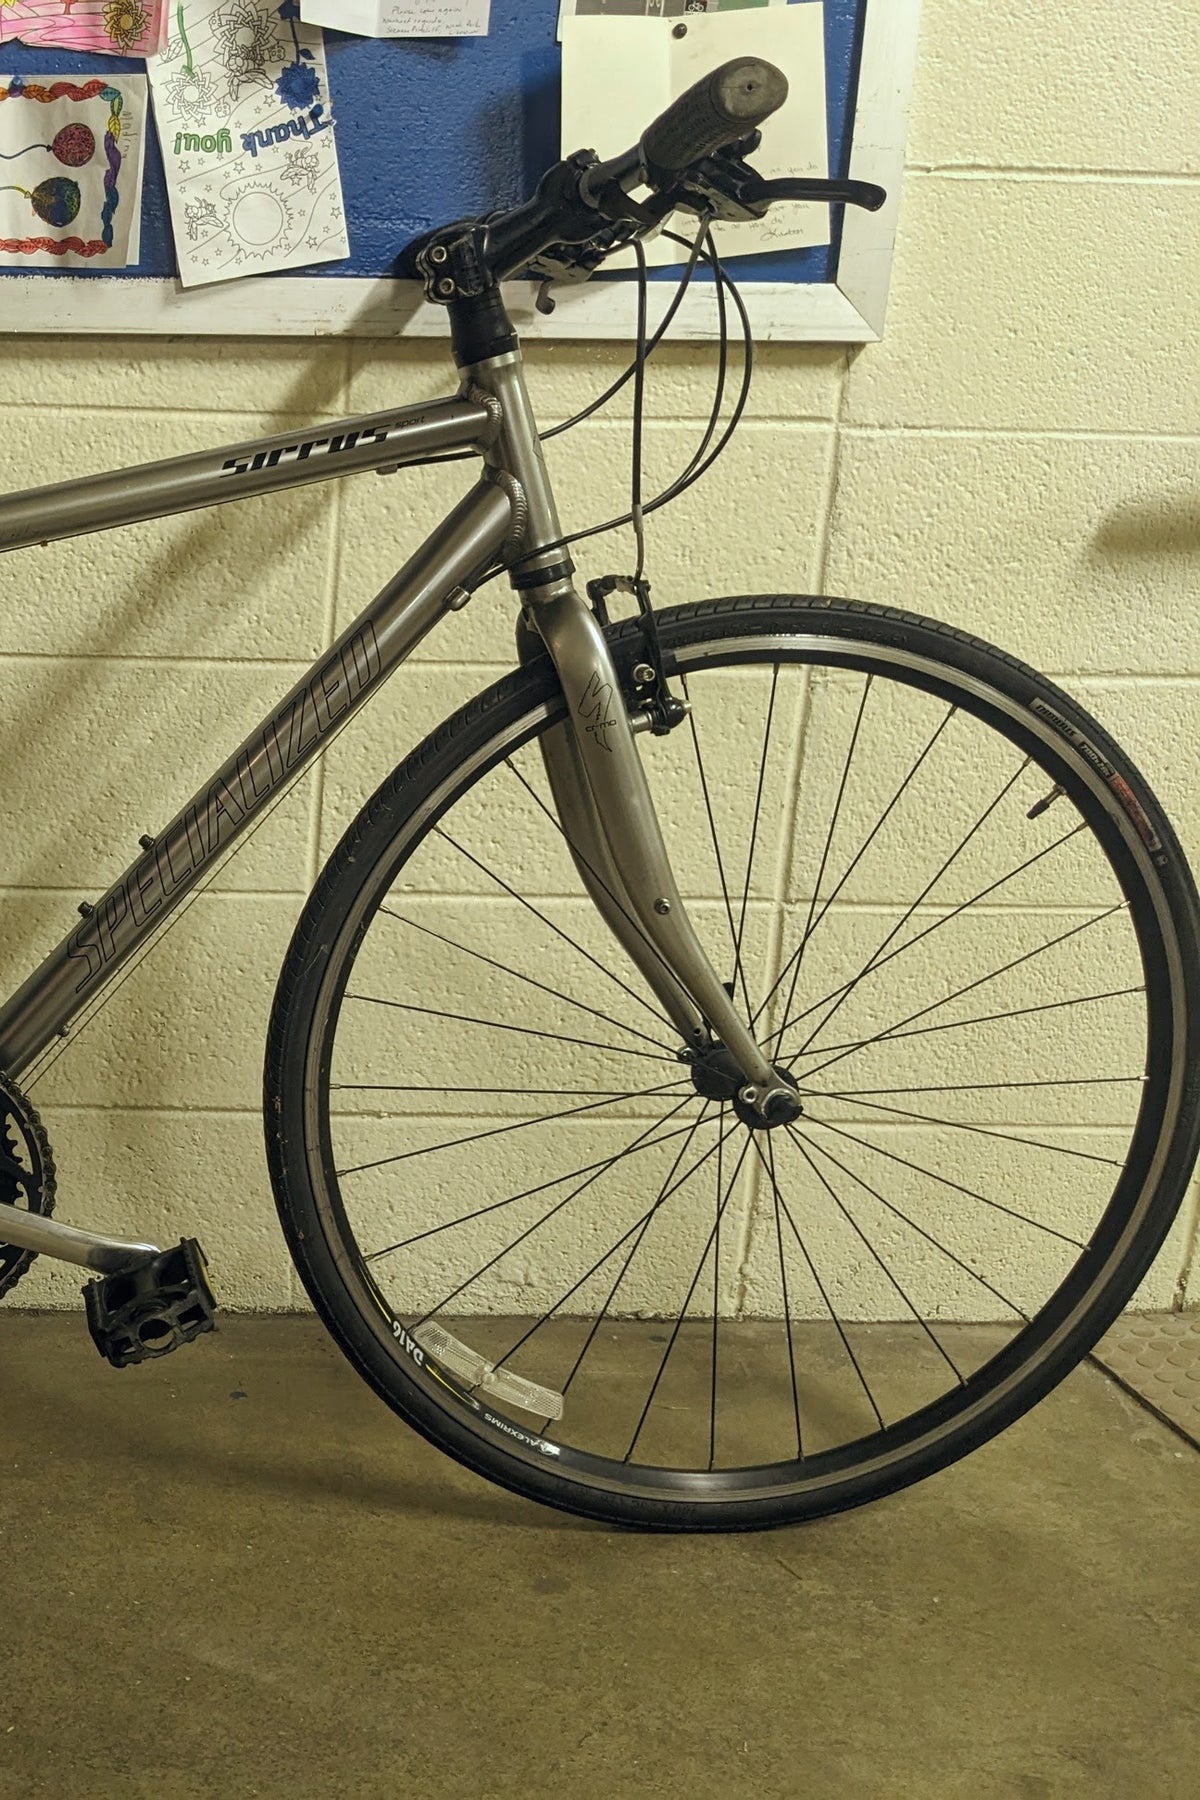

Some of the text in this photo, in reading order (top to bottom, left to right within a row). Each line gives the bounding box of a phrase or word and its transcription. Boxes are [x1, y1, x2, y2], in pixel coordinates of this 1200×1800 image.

[174, 104, 336, 157] Thank you!
[395, 415, 425, 430] sport
[67, 619, 382, 994] SPECIALIZED
[392, 1320, 425, 1367] DA16
